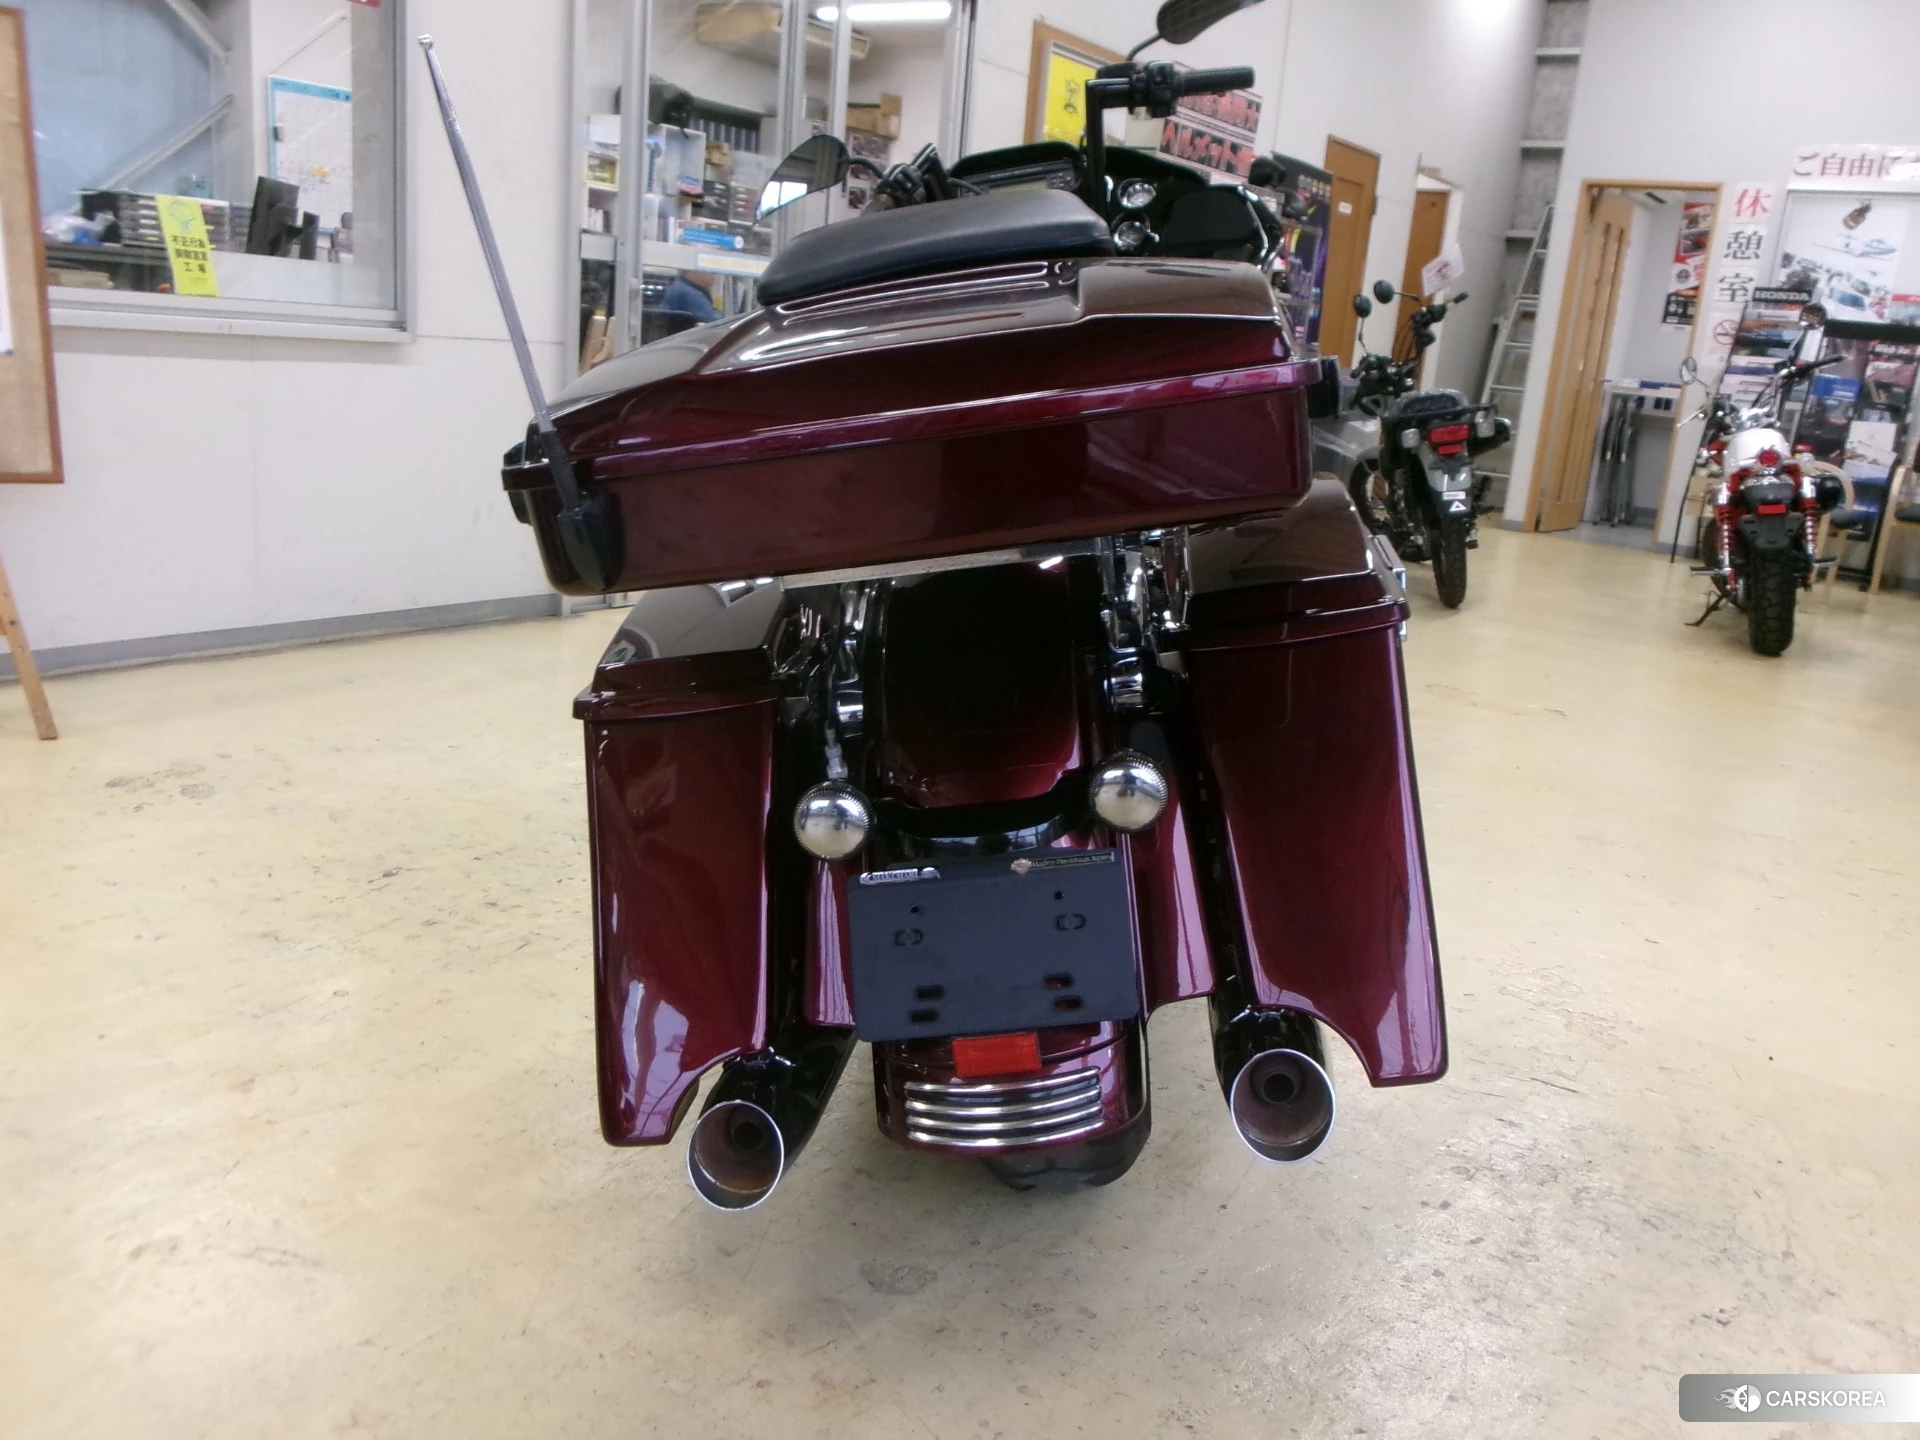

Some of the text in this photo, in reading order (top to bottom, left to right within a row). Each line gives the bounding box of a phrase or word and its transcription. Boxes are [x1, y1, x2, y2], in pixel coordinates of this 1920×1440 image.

[1793, 151, 1920, 178] ご自由に
[1718, 188, 1773, 303] 休憩室
[1753, 289, 1810, 302] HONDA
